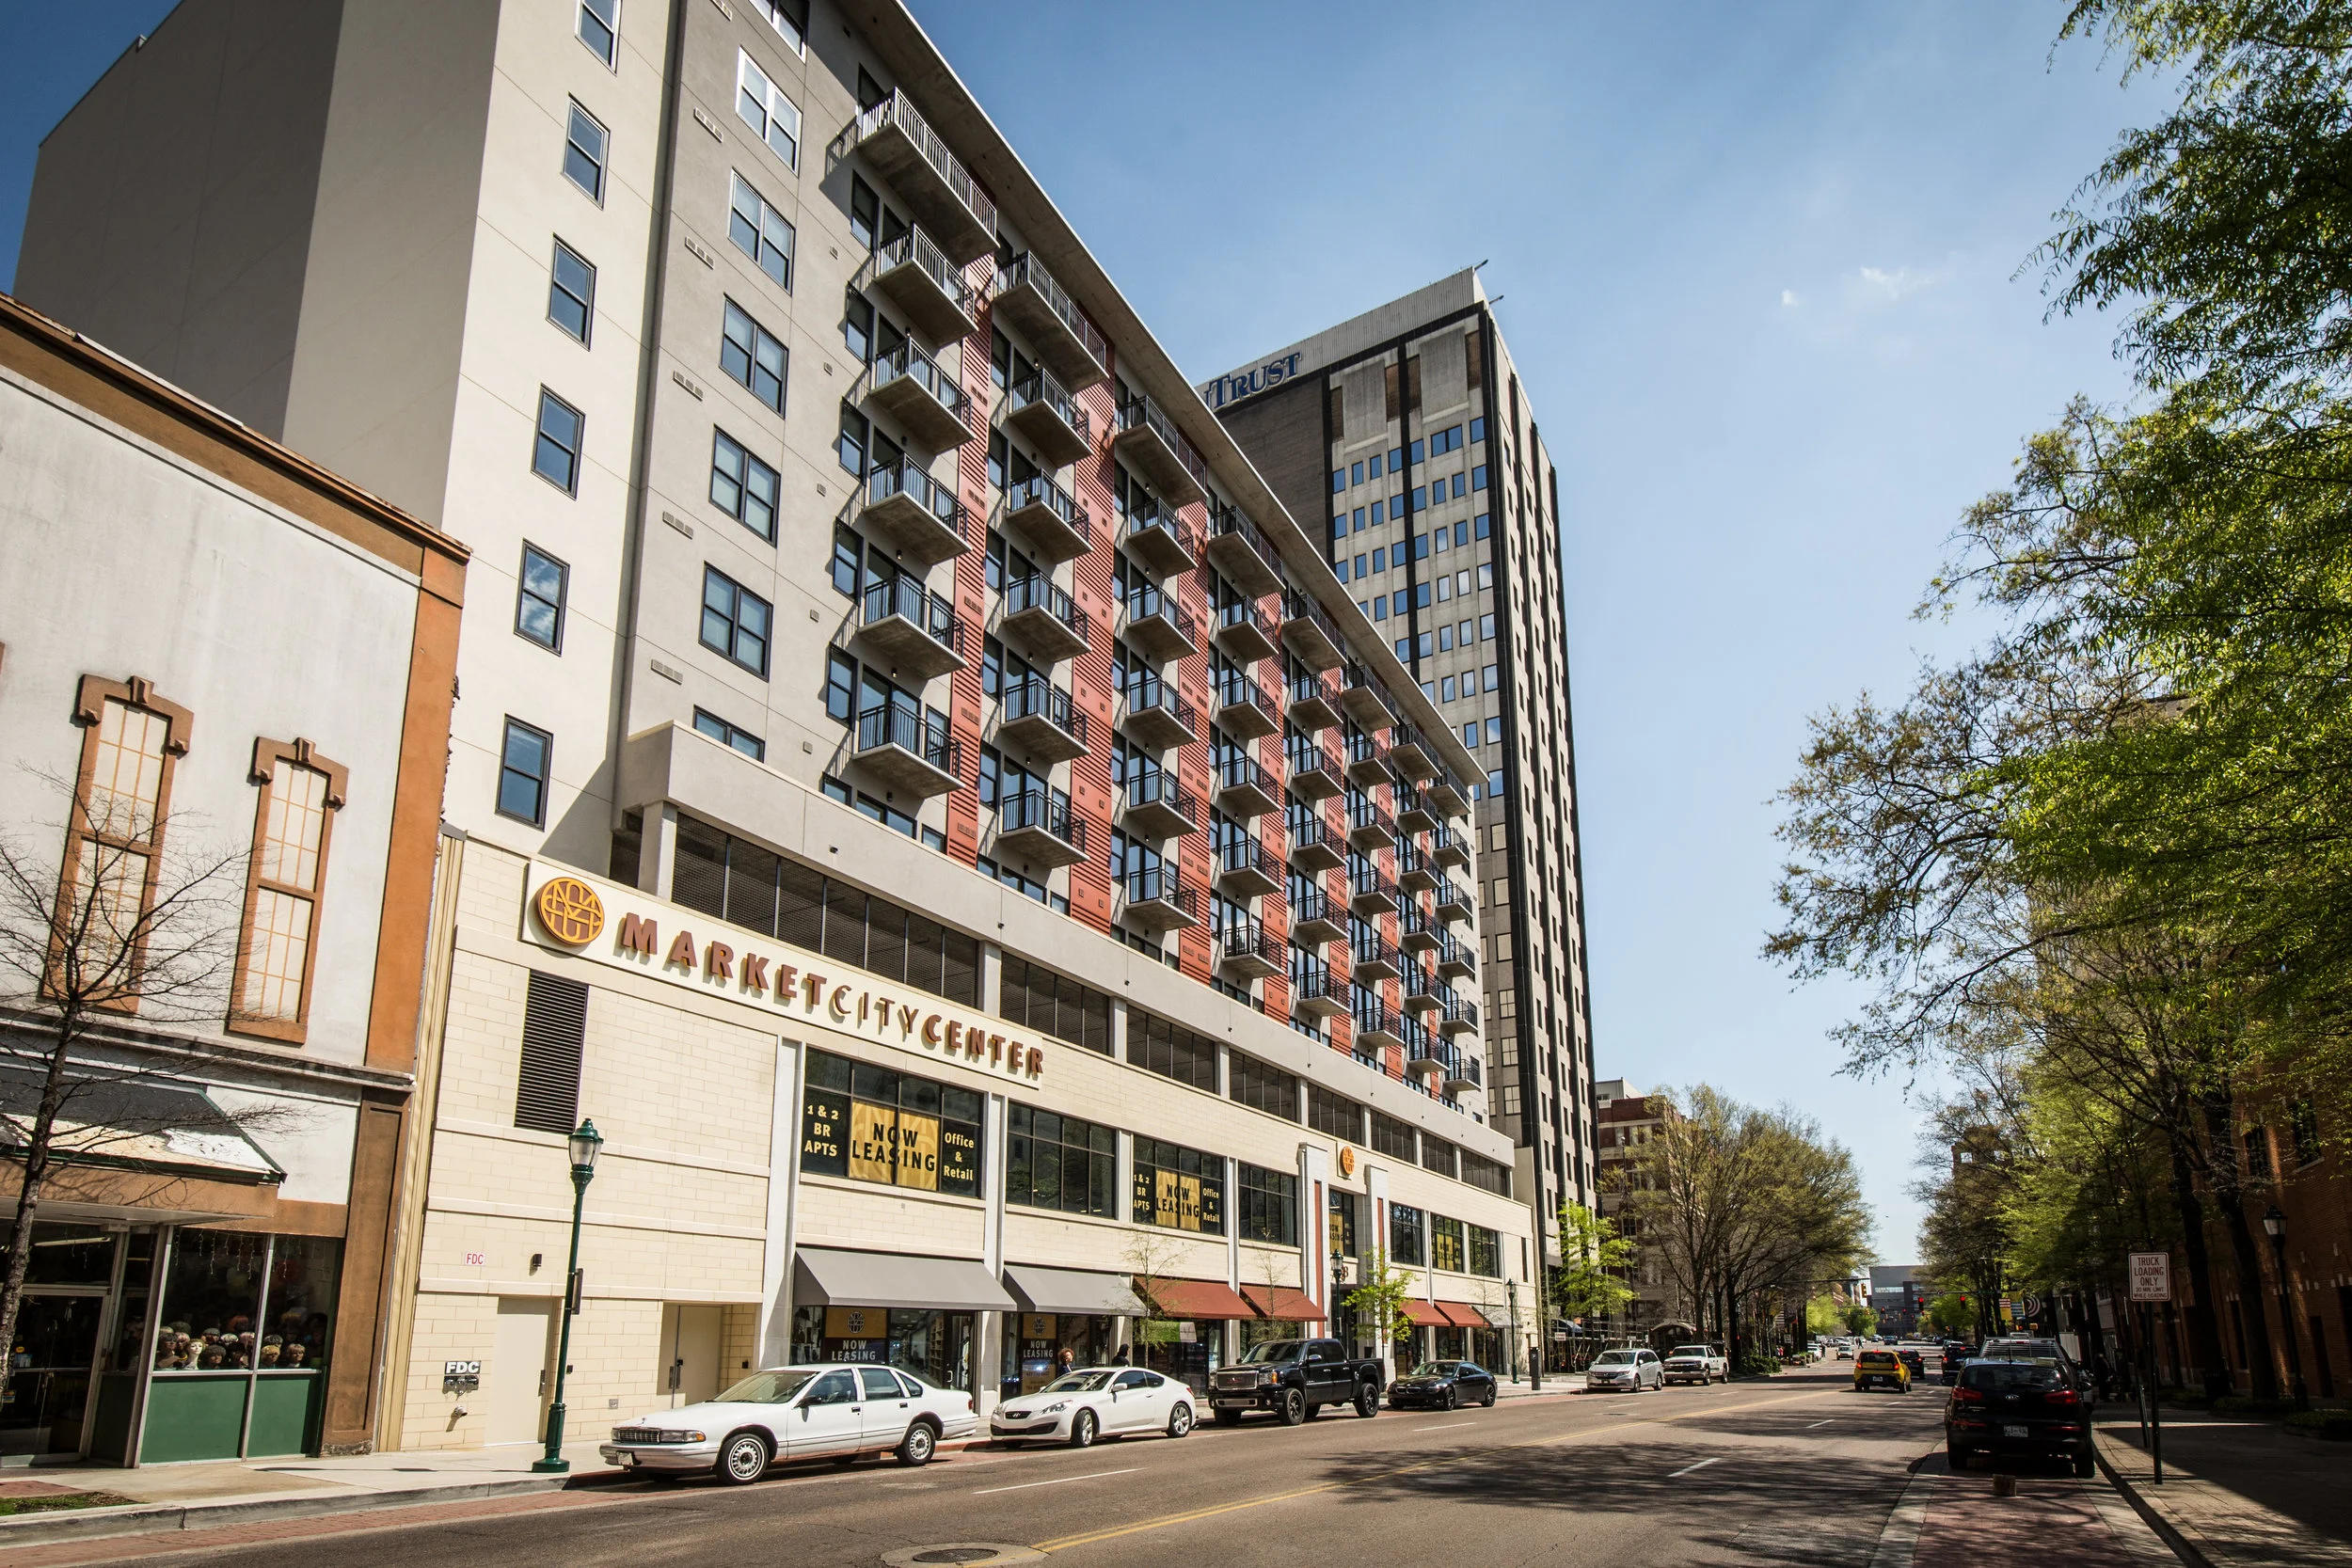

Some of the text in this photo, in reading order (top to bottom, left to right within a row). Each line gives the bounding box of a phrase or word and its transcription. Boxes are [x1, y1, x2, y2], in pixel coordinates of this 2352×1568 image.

[807, 1104, 839, 1120] 1 & 2
[813, 1122, 831, 1138] BR
[873, 1122, 918, 1148] NOW
[945, 1132, 975, 1148] Office
[804, 1140, 838, 1157] APTS
[851, 1140, 935, 1172] LEASING
[955, 1151, 962, 1163] &
[944, 1166, 974, 1181] Retail
[1136, 1186, 1146, 1196] BR
[1202, 1188, 1219, 1199] Office
[1133, 1199, 1150, 1211] APTS
[1203, 1212, 1219, 1223] Retail
[466, 1253, 485, 1264] FDC
[2137, 1257, 2160, 1266] TRUCK
[2134, 1266, 2164, 1276] LOADING
[2139, 1276, 2158, 1286] ONLY
[842, 1339, 866, 1350] NOW
[1030, 1340, 1046, 1349] NOW
[831, 1351, 876, 1361] LEASING
[1023, 1349, 1054, 1358] LEASING
[445, 1361, 480, 1374] FDC
